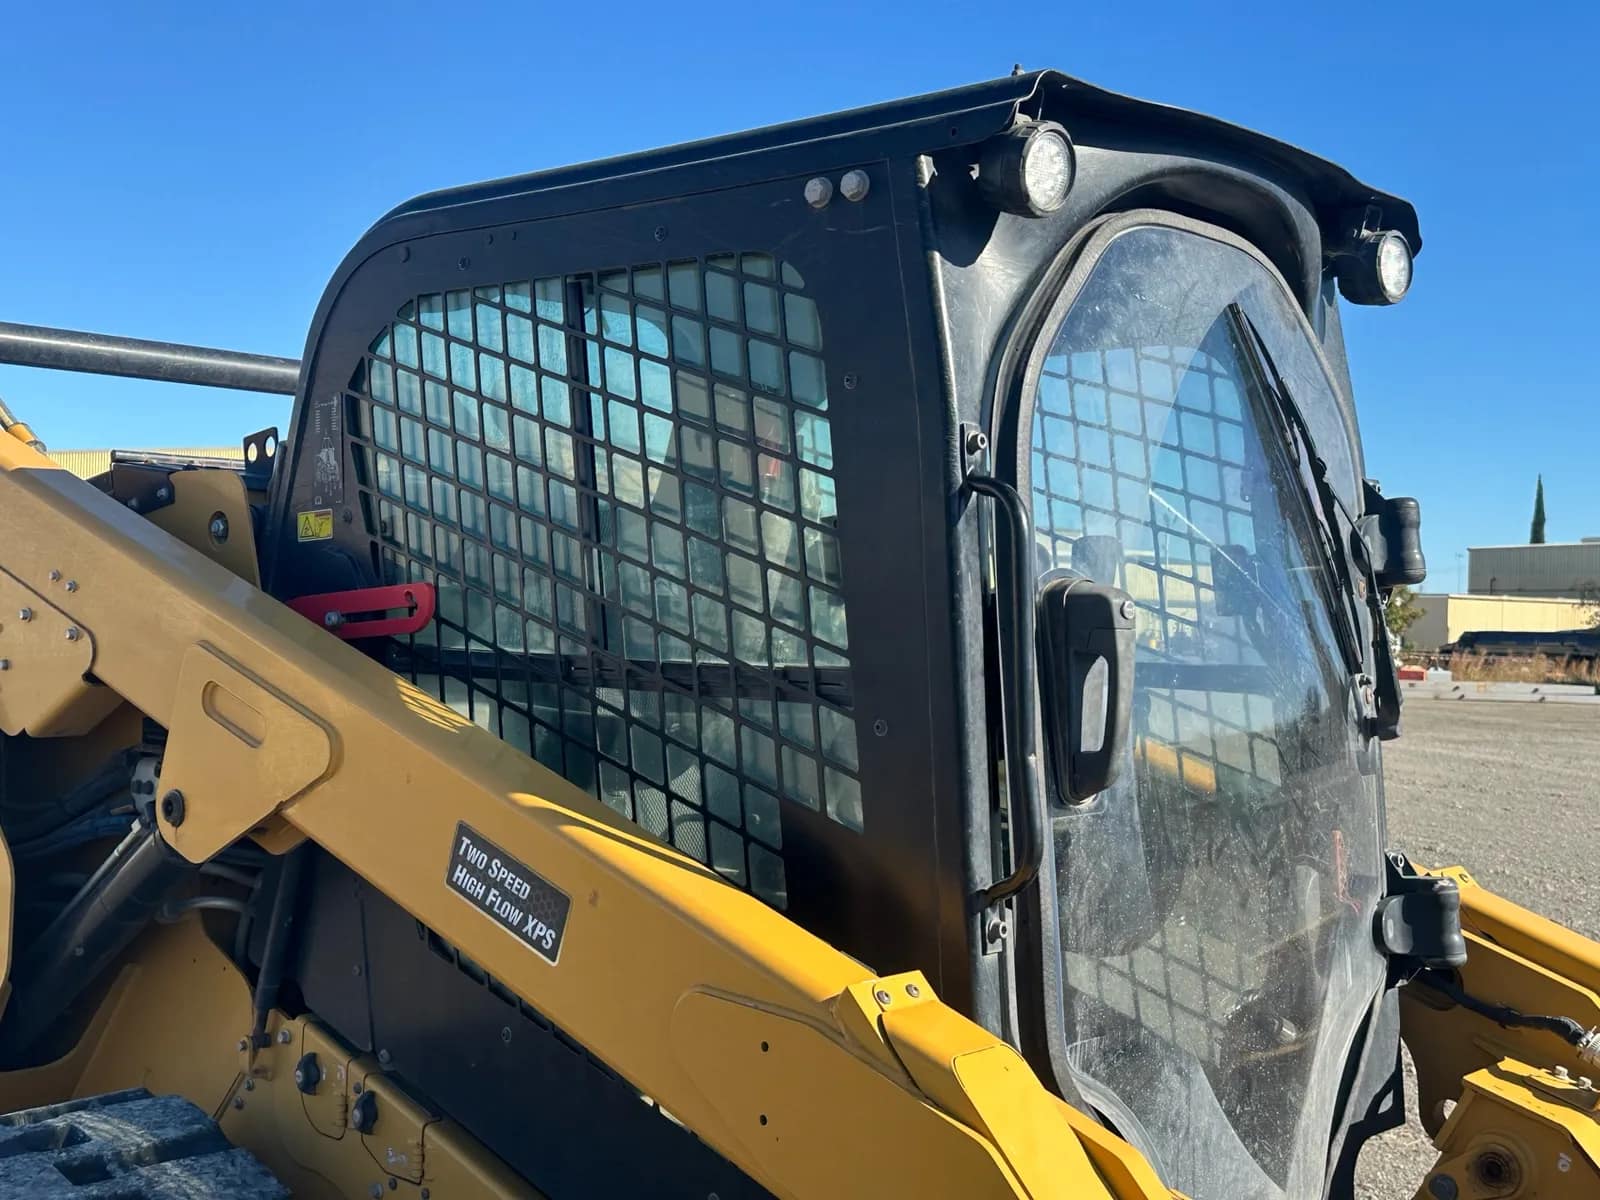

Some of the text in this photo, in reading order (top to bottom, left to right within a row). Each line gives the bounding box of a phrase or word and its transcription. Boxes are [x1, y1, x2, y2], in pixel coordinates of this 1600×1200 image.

[458, 836, 531, 900] TWO SPEED
[452, 864, 556, 950] HIGH FLOW XPS
